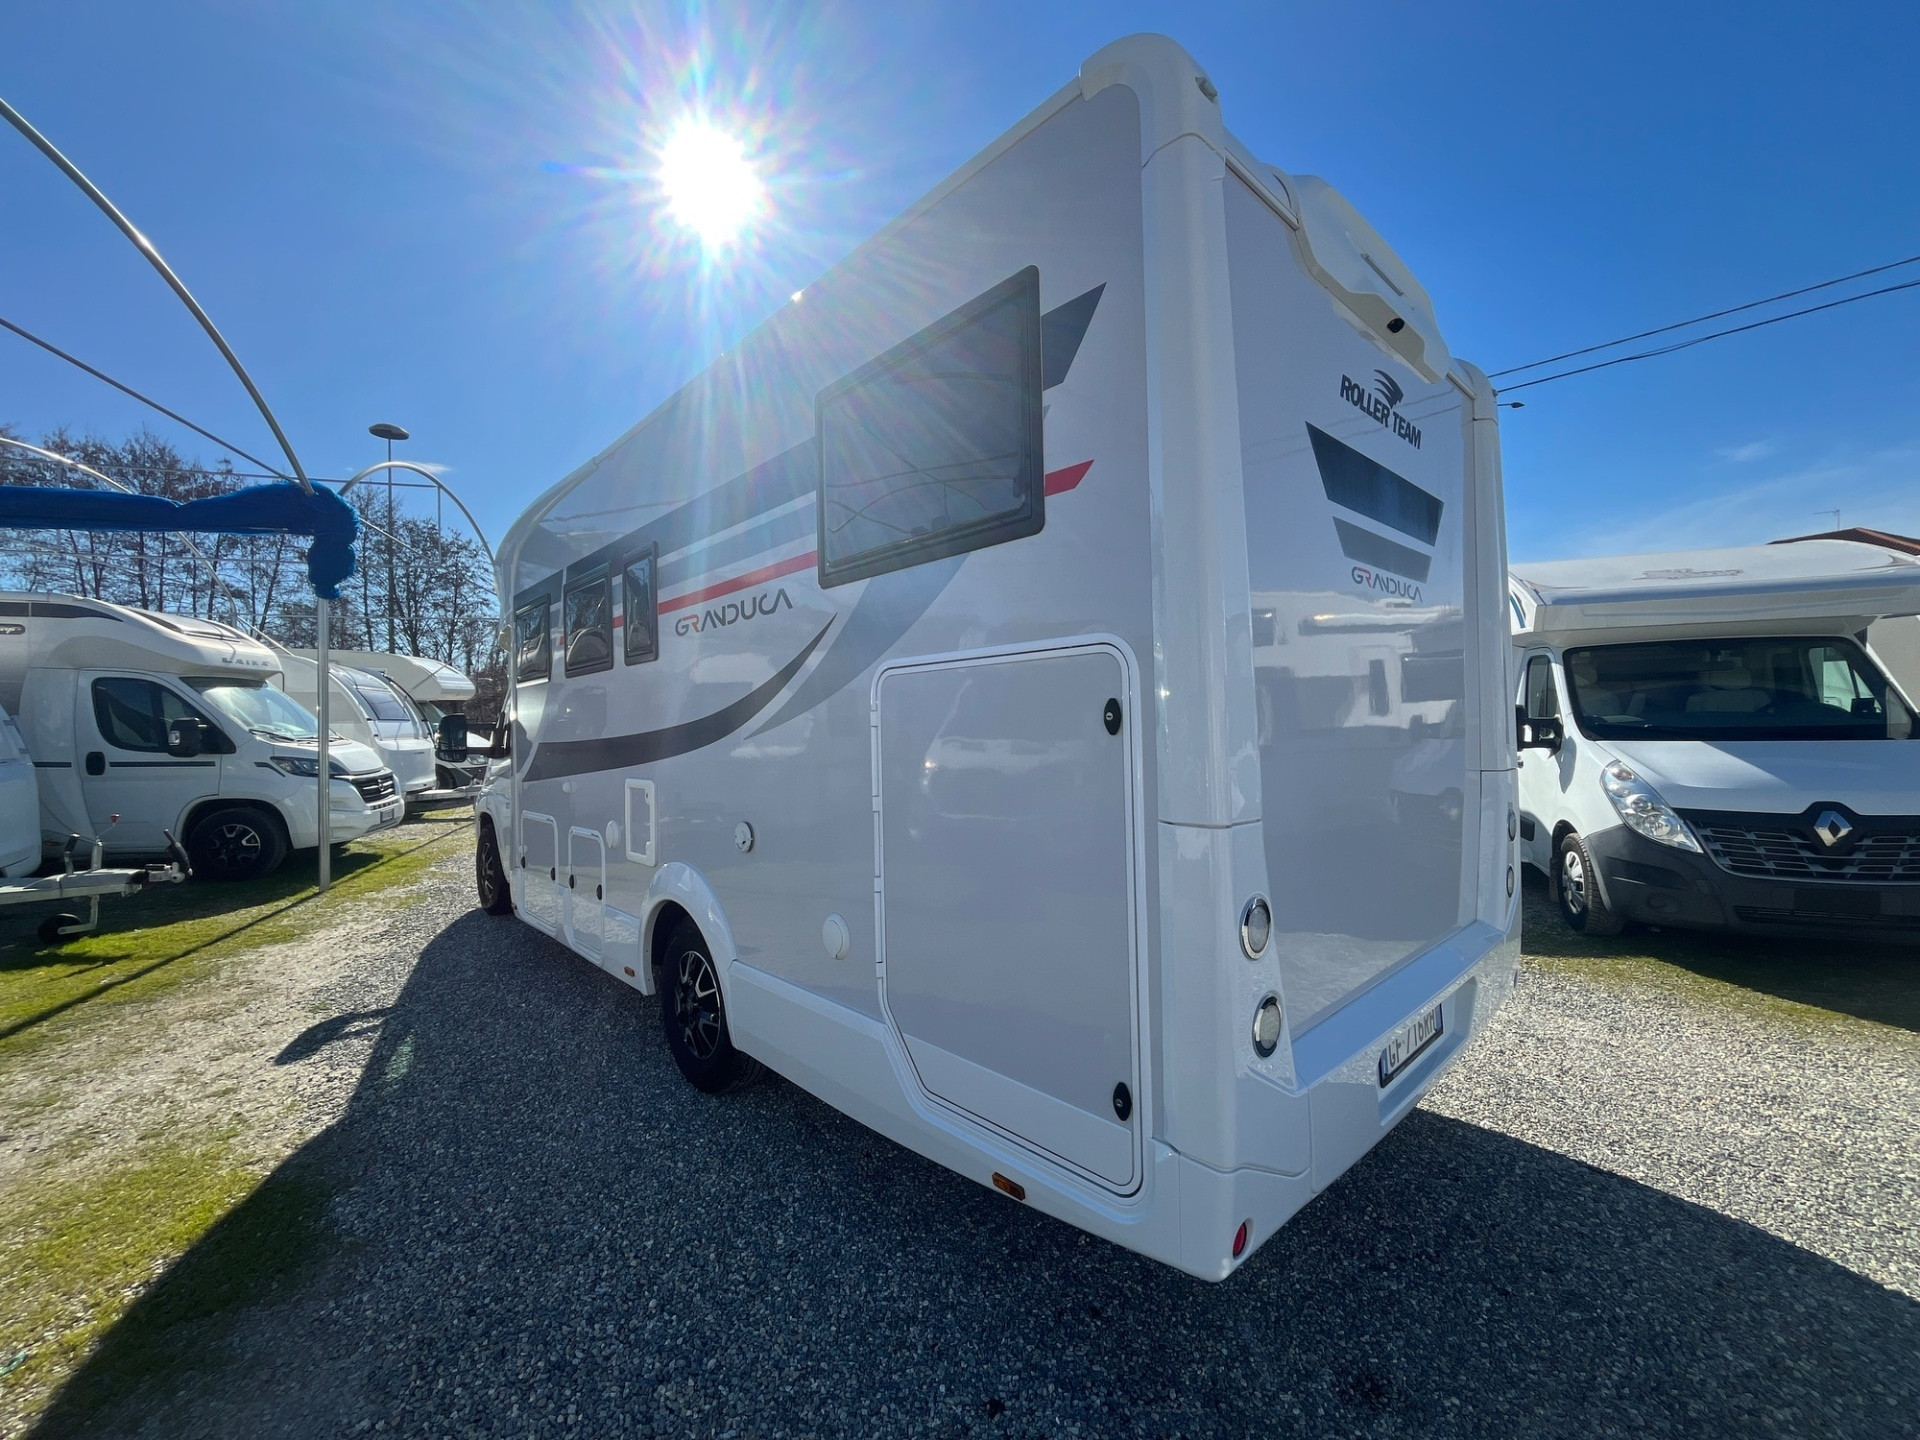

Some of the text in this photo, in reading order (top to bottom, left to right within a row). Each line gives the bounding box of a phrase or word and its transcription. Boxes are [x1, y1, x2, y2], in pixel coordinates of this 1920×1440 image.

[1339, 373, 1422, 450] ROLLER TEAM
[1351, 566, 1423, 602] GRANDUCA
[675, 588, 793, 636] GRANDUCA
